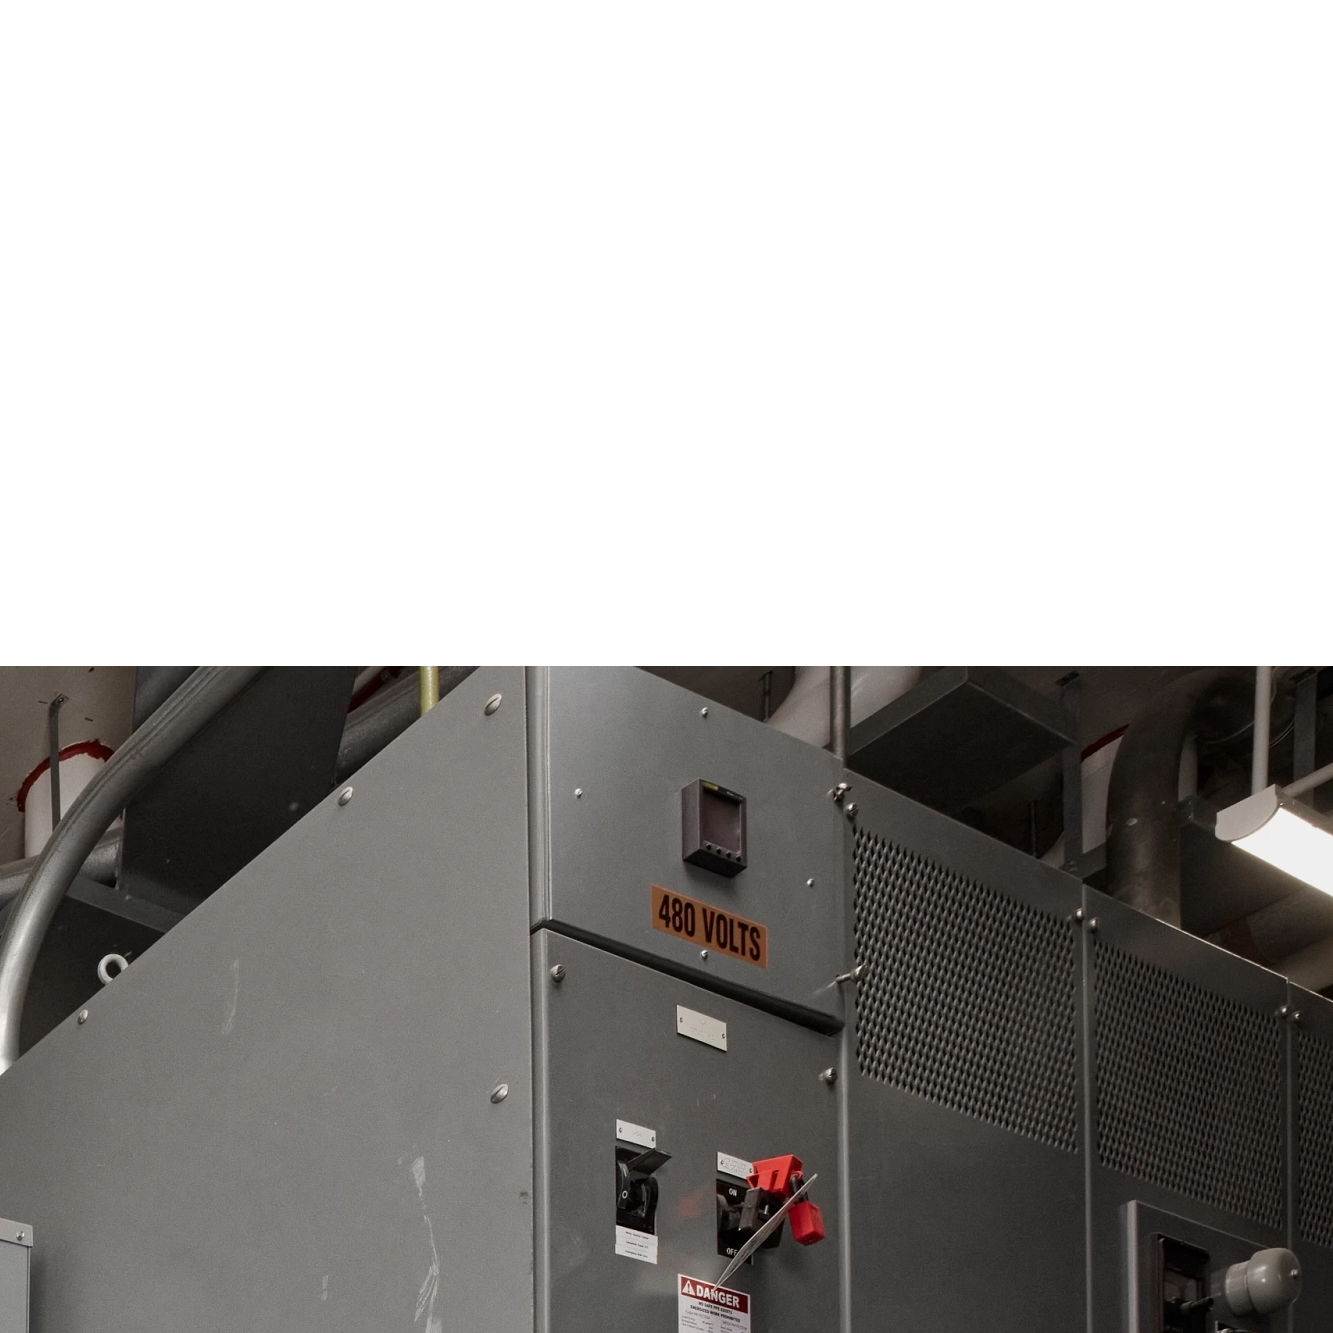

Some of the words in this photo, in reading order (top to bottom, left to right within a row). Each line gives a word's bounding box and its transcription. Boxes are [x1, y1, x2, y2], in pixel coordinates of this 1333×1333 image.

[658, 894, 696, 938] 480
[702, 907, 761, 961] VOLTS
[728, 1187, 738, 1197] ON
[726, 1247, 738, 1257] OFF
[696, 1284, 740, 1308] DANGER
